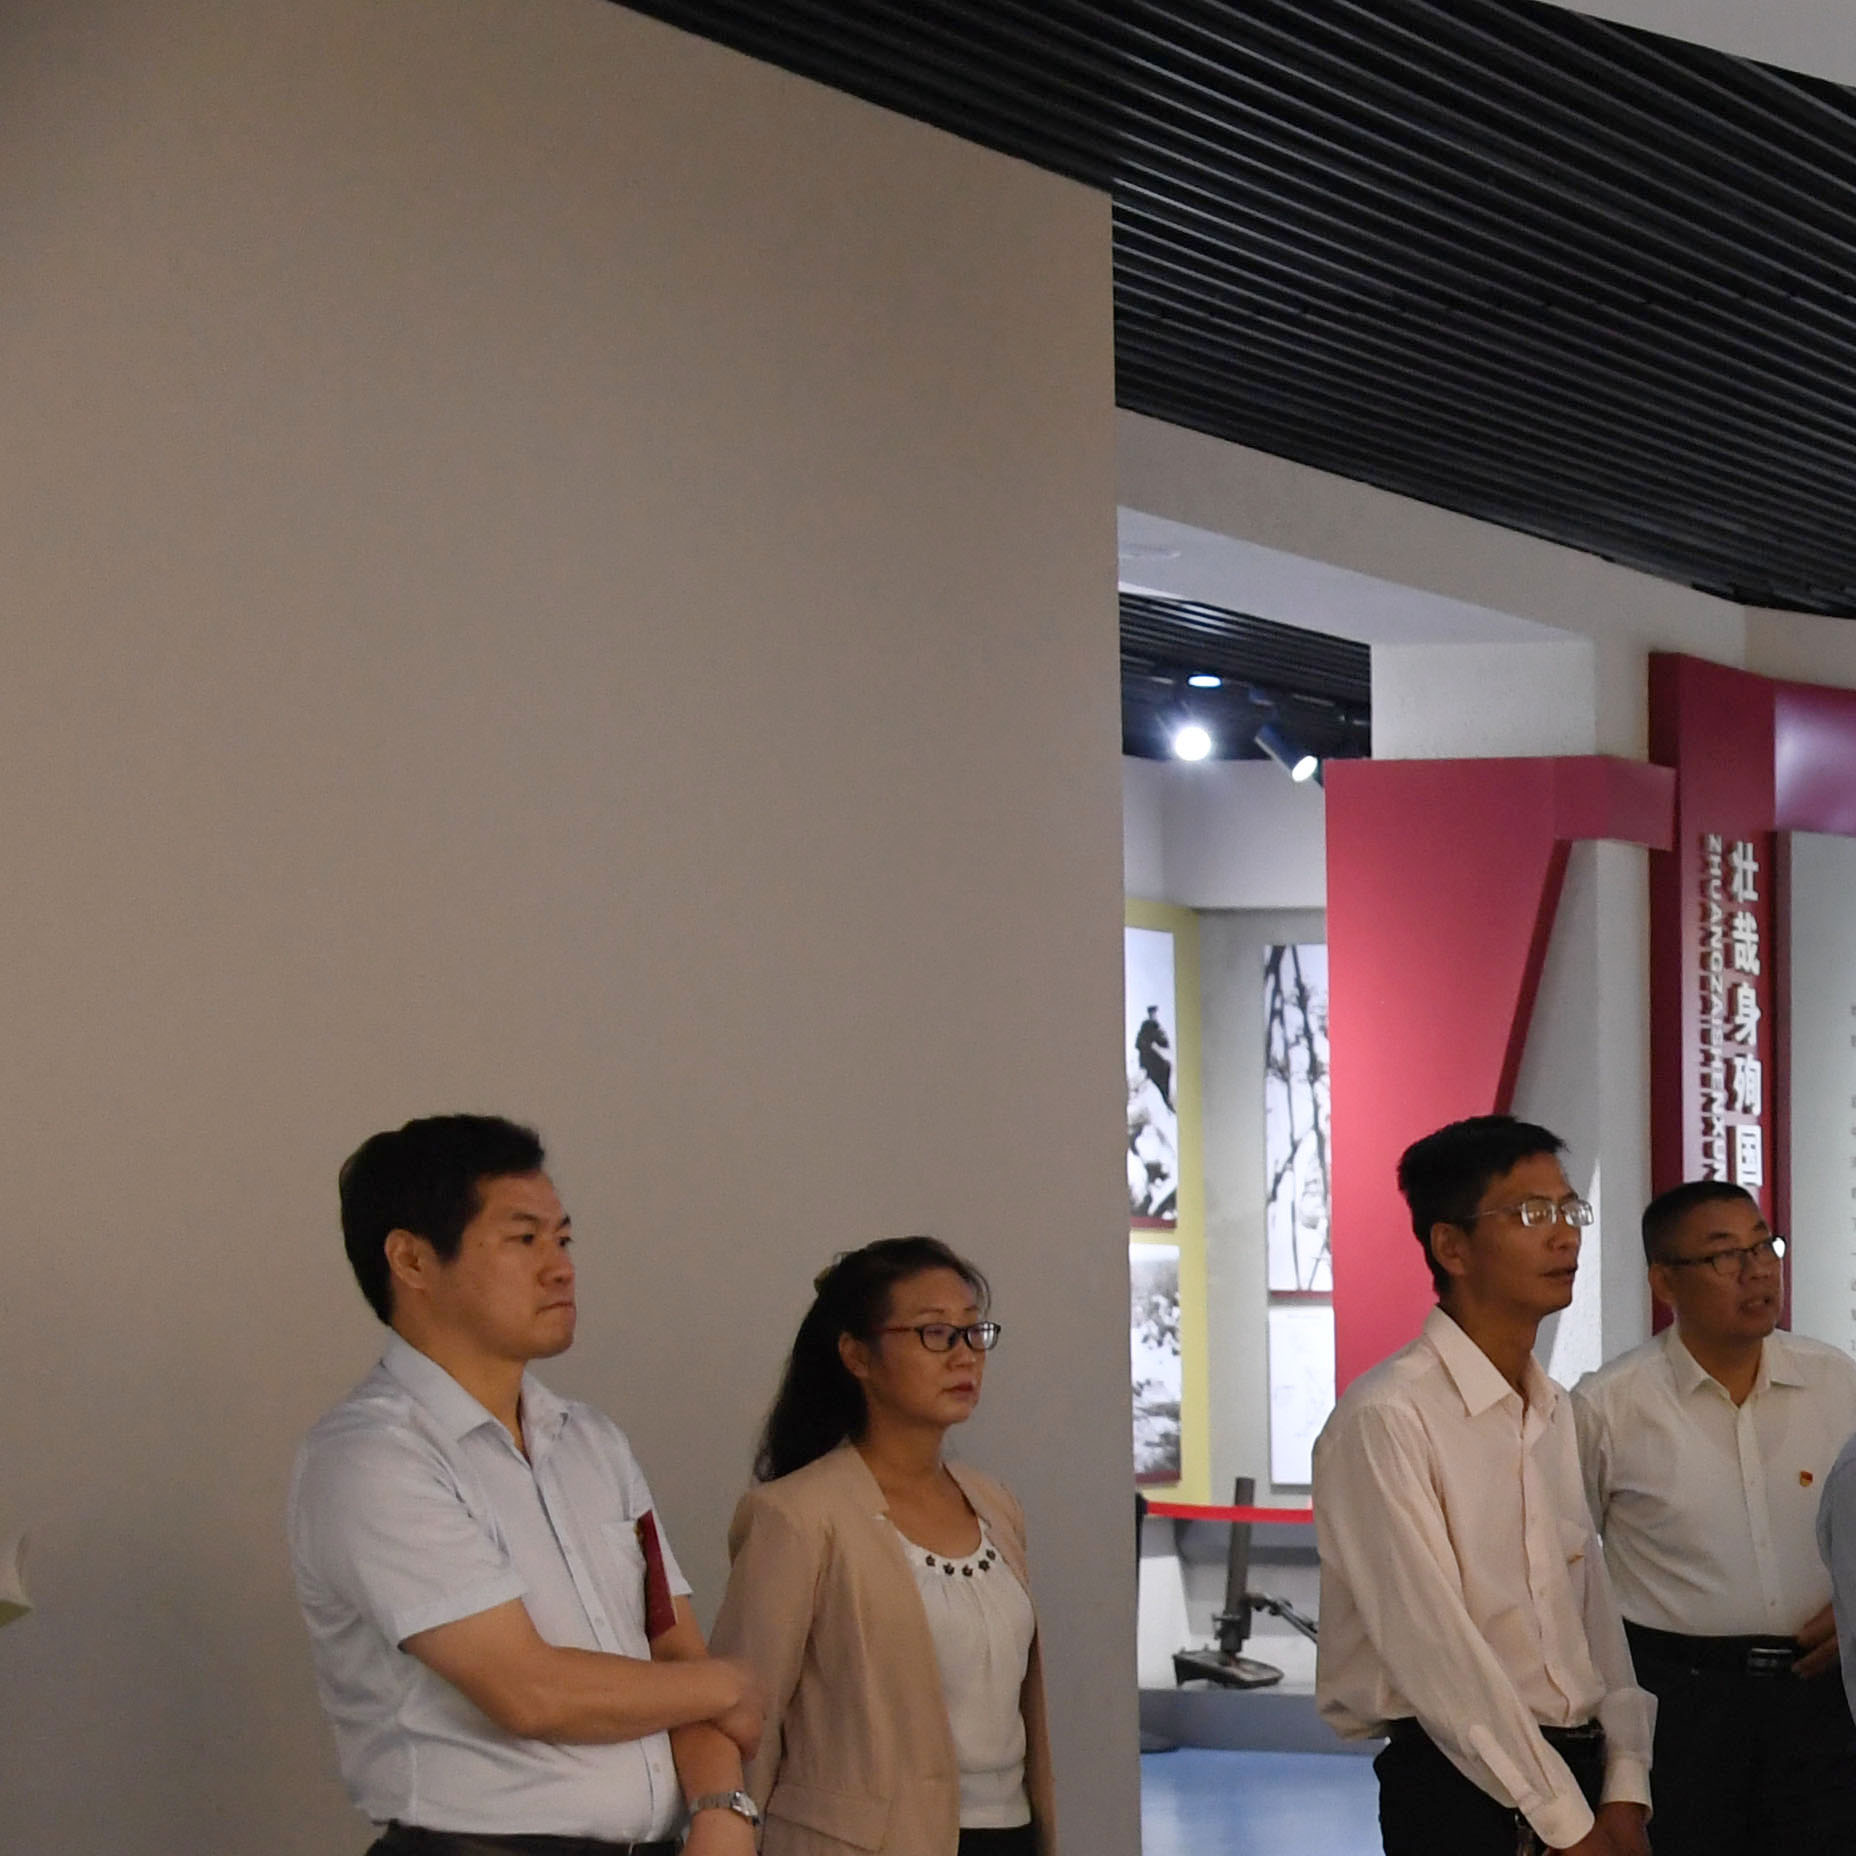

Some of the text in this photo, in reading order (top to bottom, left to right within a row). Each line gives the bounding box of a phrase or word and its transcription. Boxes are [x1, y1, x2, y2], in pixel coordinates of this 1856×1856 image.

[1730, 840, 1763, 1187] 壮哉身殉国
